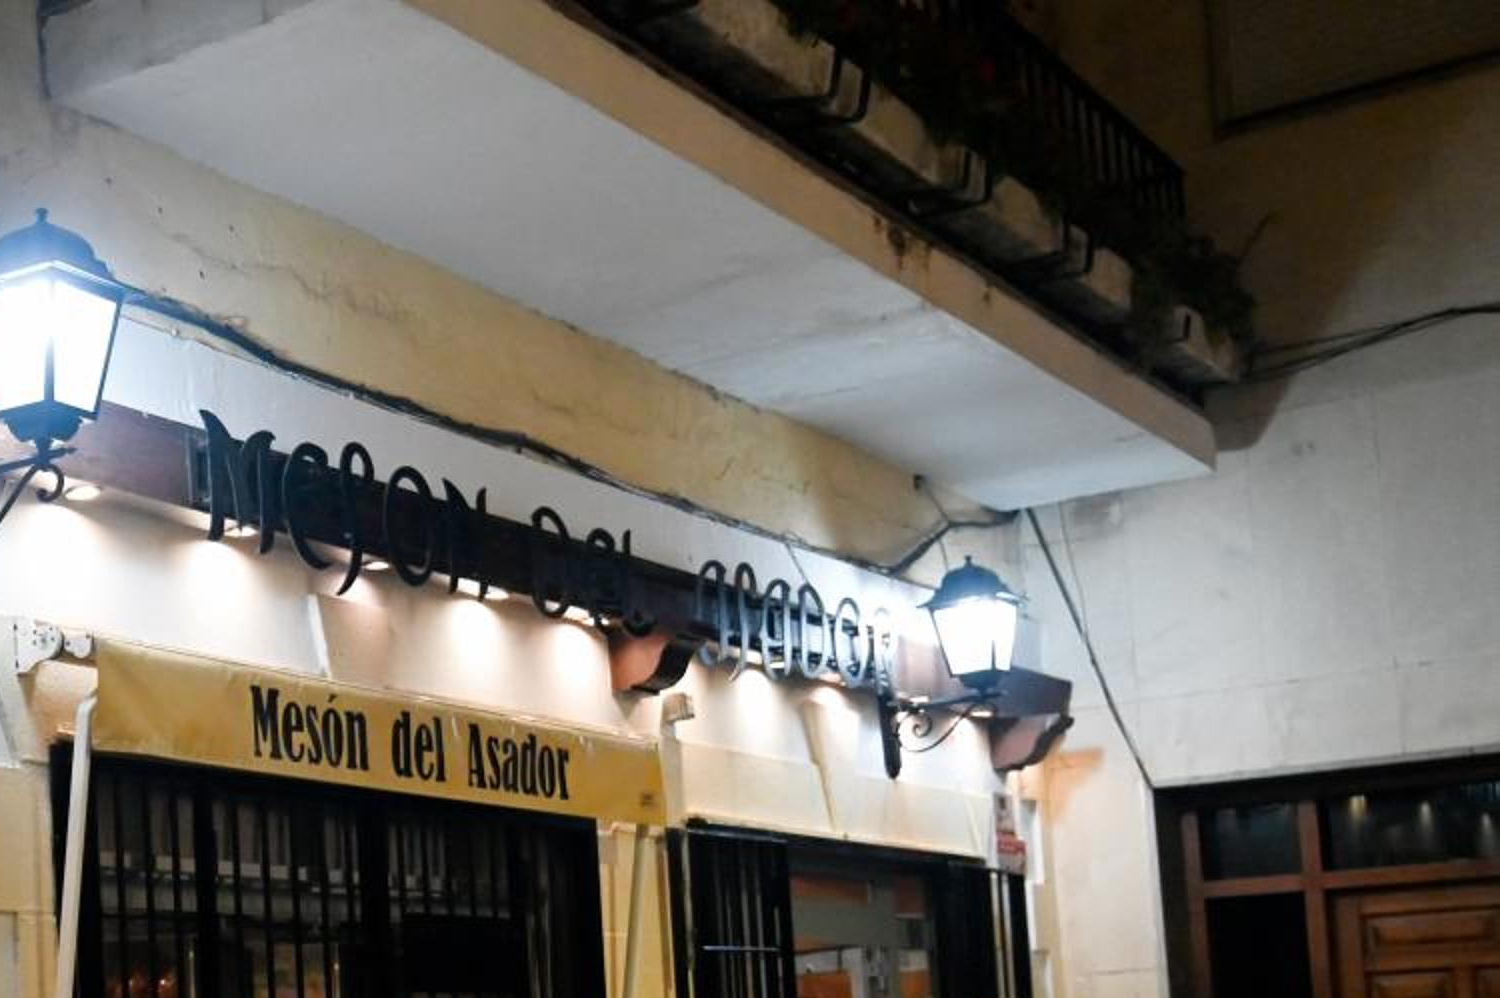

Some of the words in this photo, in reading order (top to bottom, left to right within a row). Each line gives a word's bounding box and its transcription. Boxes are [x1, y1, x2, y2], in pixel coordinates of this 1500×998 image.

[249, 685, 369, 771] Mesón
[391, 711, 447, 782] del
[467, 724, 570, 800] Asador
